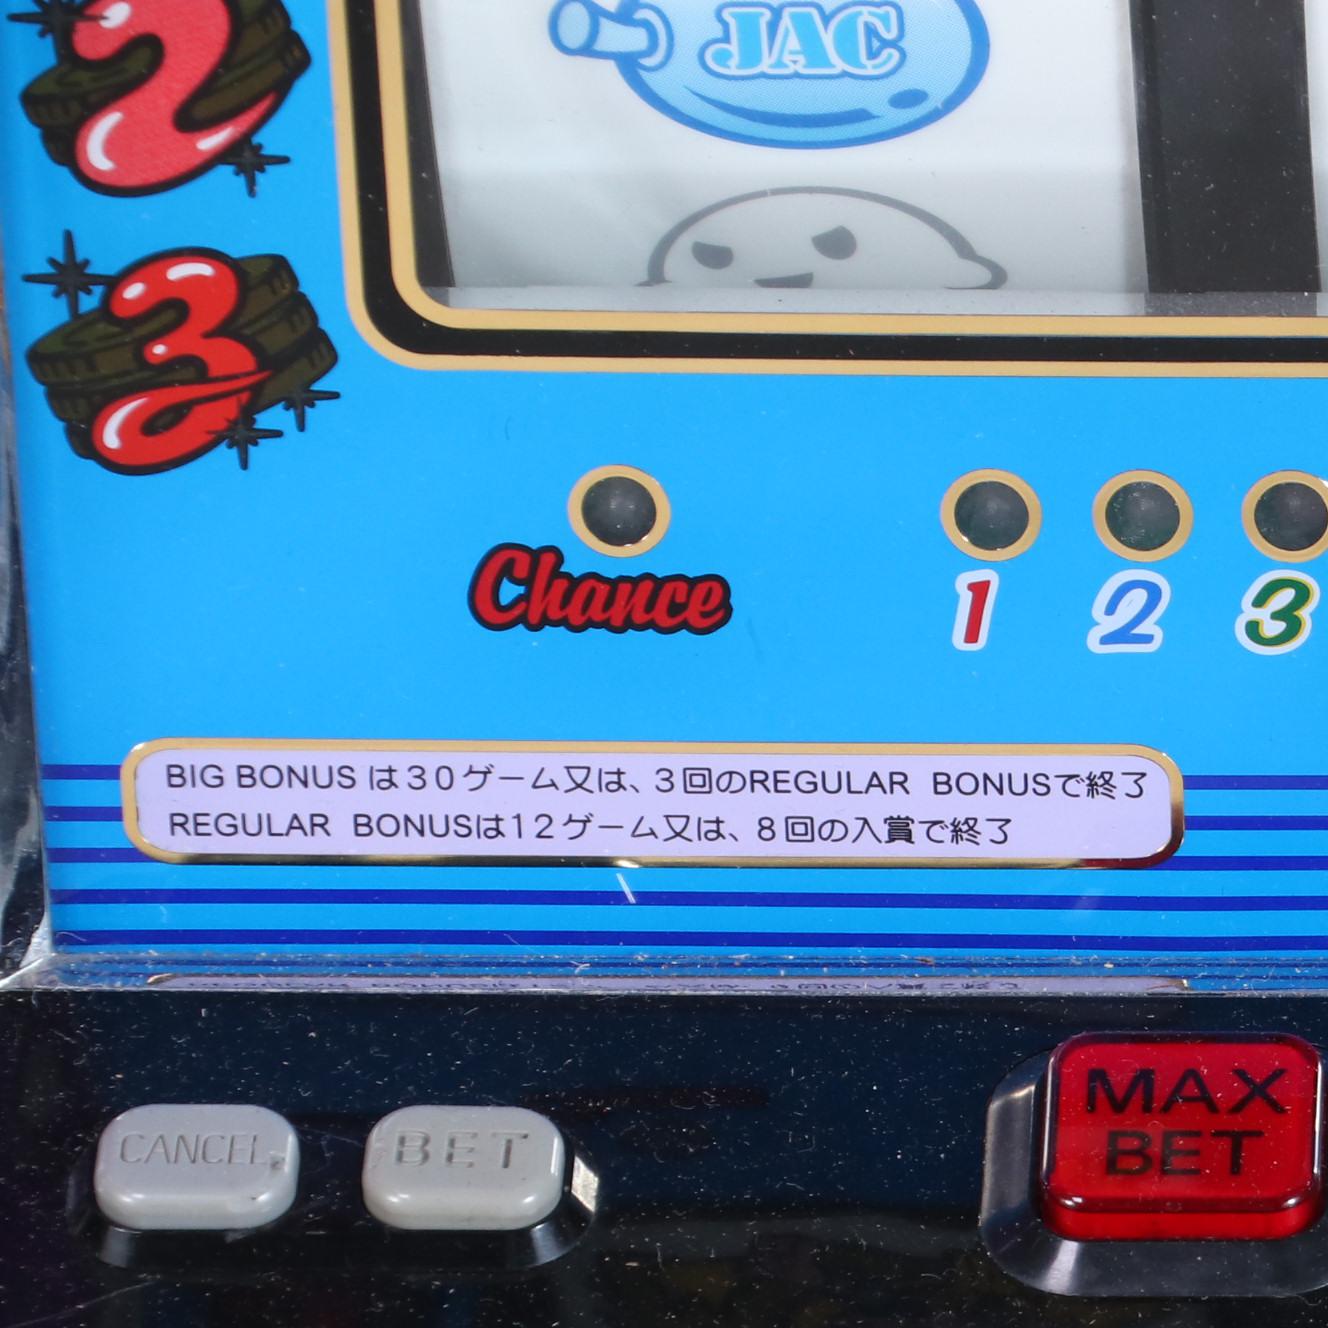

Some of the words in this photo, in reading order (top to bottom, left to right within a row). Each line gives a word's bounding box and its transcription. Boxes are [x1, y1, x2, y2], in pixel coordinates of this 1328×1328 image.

[704, 5, 901, 76] JAC
[468, 543, 733, 636] Chance
[959, 575, 995, 647] 1
[1094, 577, 1167, 650] 2
[1240, 573, 1315, 650] 3
[166, 764, 225, 790] BIG
[236, 765, 357, 791] BONUS
[932, 769, 1148, 799] BONUSで終了
[169, 812, 331, 838] REGULAR
[1085, 1068, 1289, 1115] MAX
[119, 1133, 269, 1166] CANCEL
[394, 1129, 530, 1170] BET
[1105, 1129, 1265, 1177] BET
